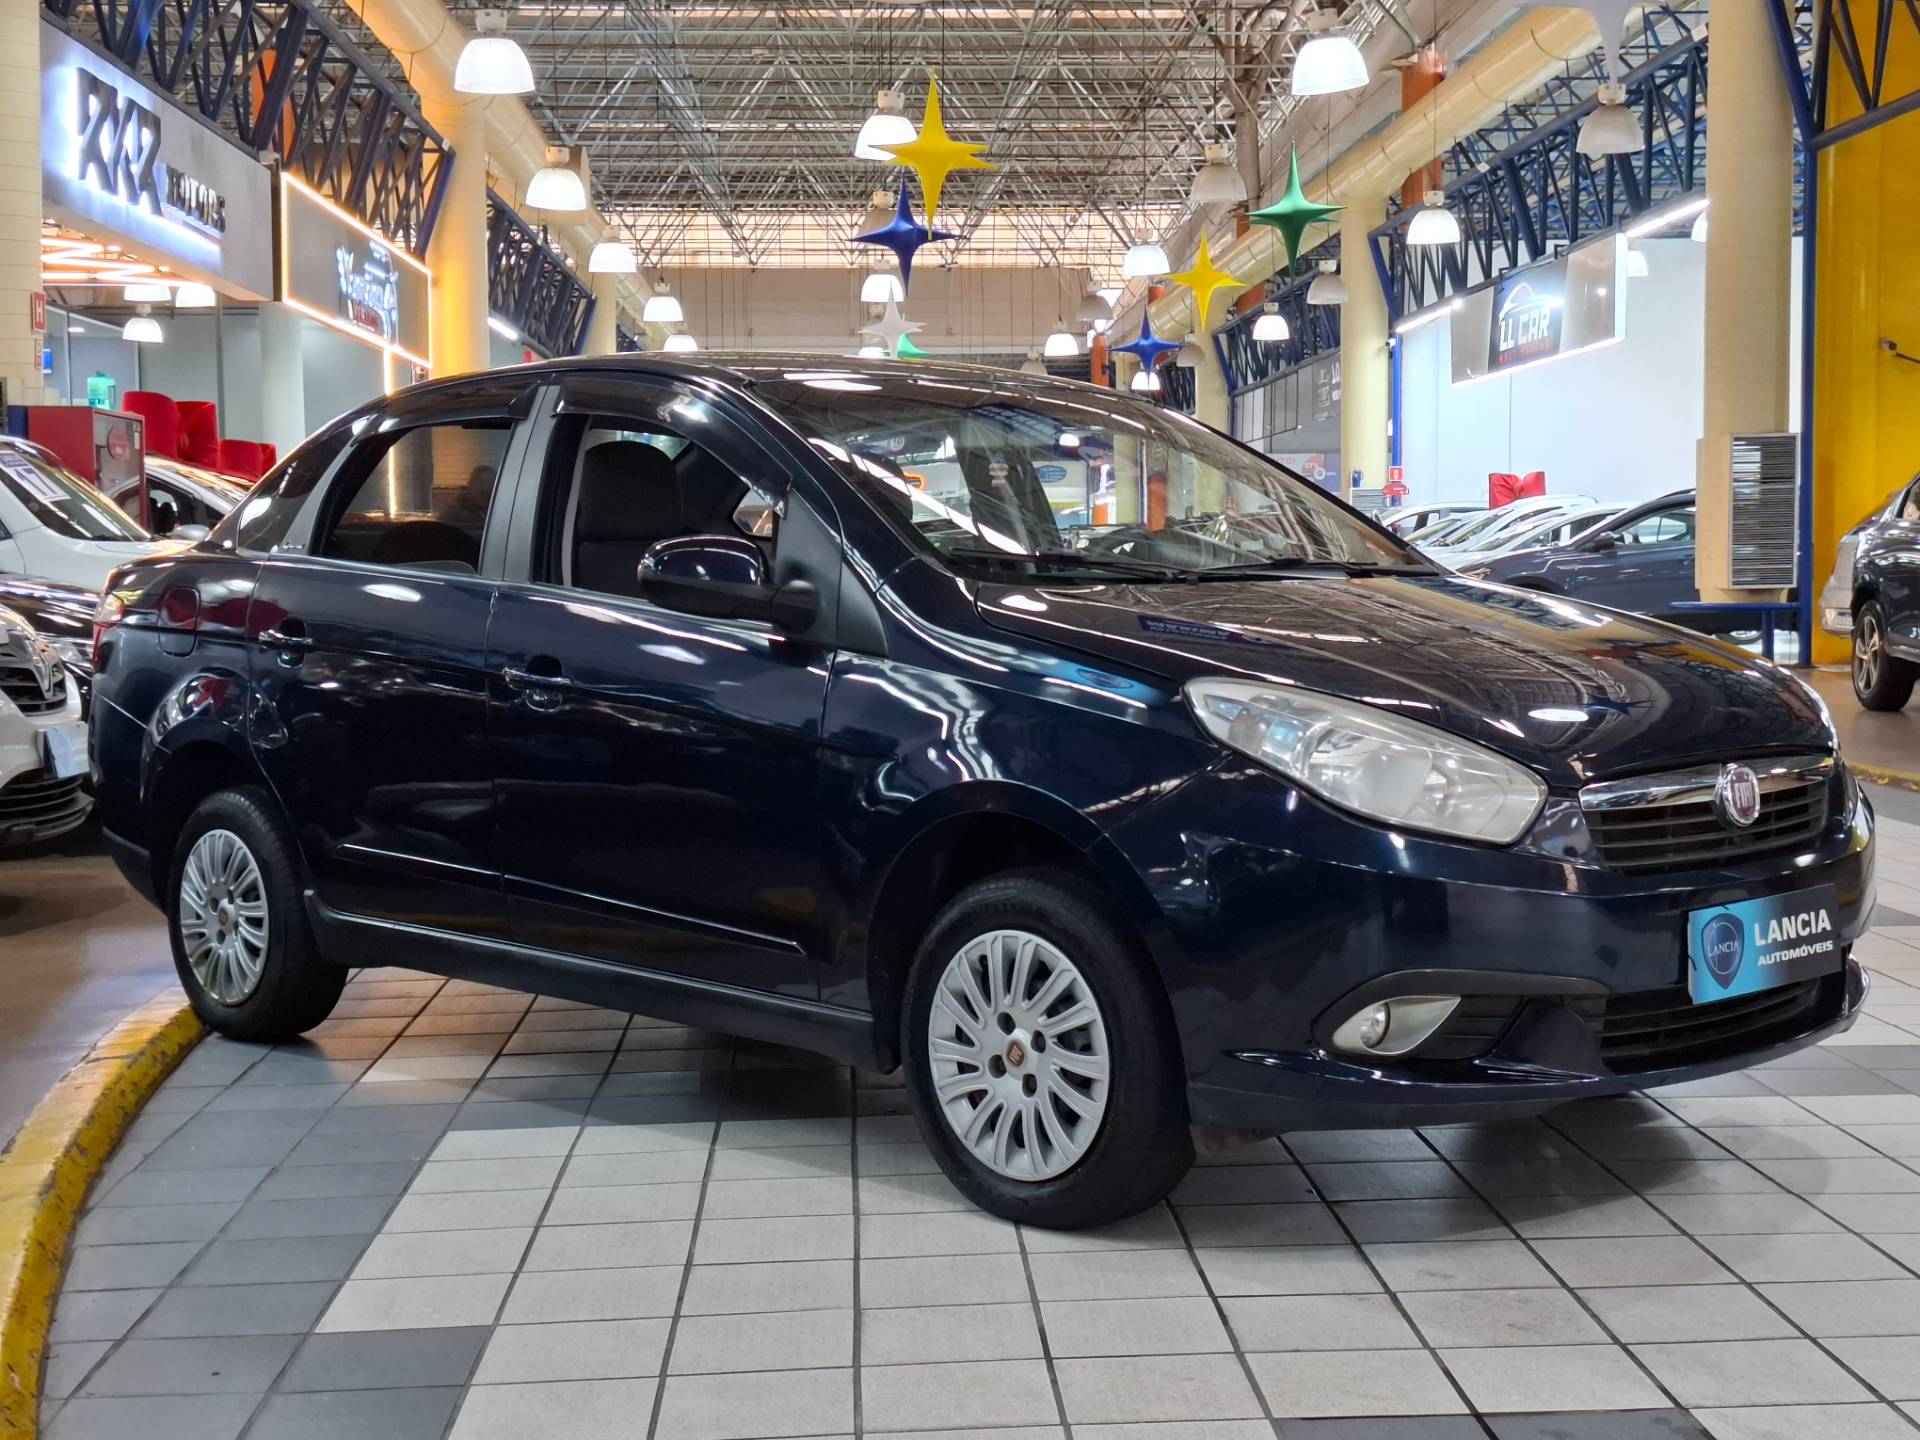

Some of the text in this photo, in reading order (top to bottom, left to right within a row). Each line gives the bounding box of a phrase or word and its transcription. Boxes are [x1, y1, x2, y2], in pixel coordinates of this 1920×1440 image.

[1517, 305, 1551, 346] CAR
[1754, 908, 1832, 947] LANCIA
[1707, 941, 1740, 957] LANCIA
[1757, 940, 1834, 967] AUTOMÓVEIS
